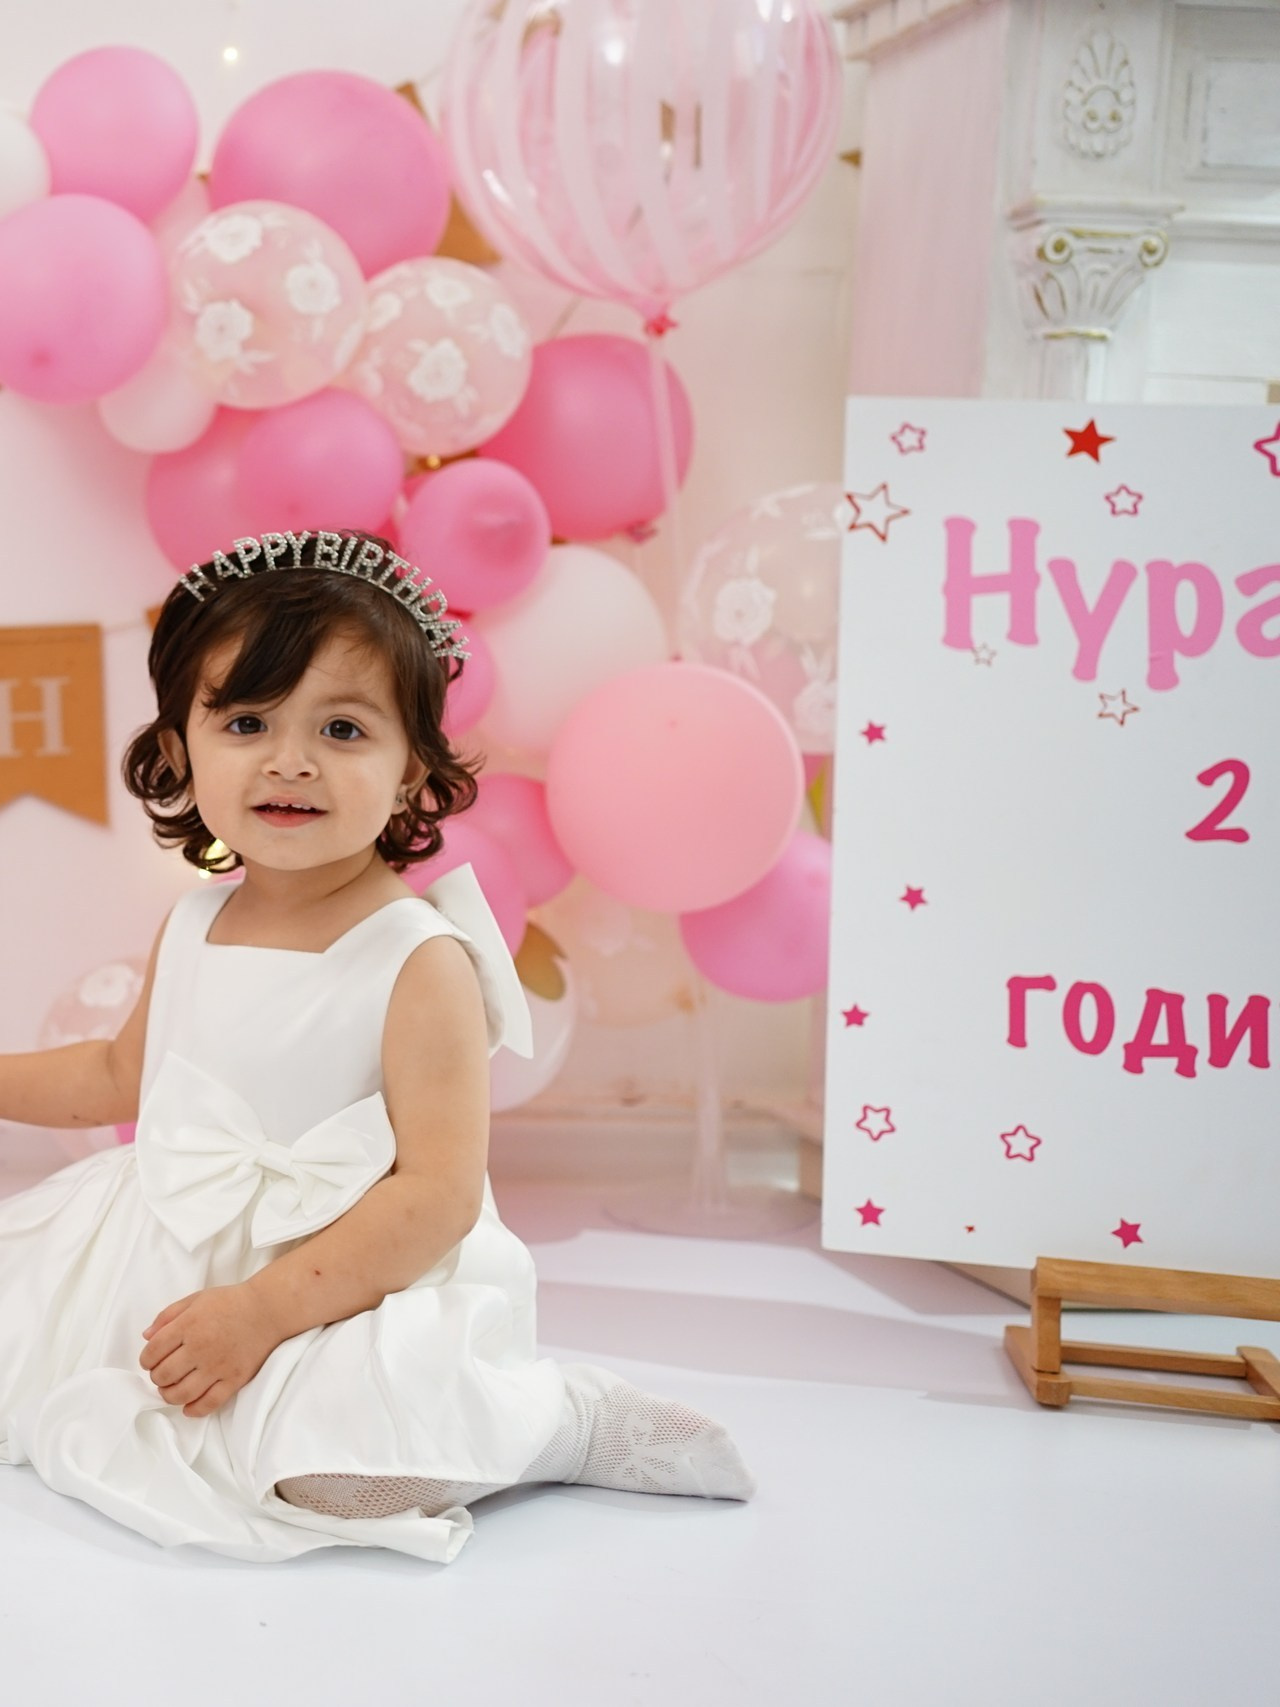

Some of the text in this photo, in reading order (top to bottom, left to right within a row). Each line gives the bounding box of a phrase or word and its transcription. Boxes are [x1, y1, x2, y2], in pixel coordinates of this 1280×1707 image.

[180, 530, 472, 660] HAPPY BIRTHDAY
[1185, 758, 1251, 843] 2
[1007, 974, 1280, 1079] годи
